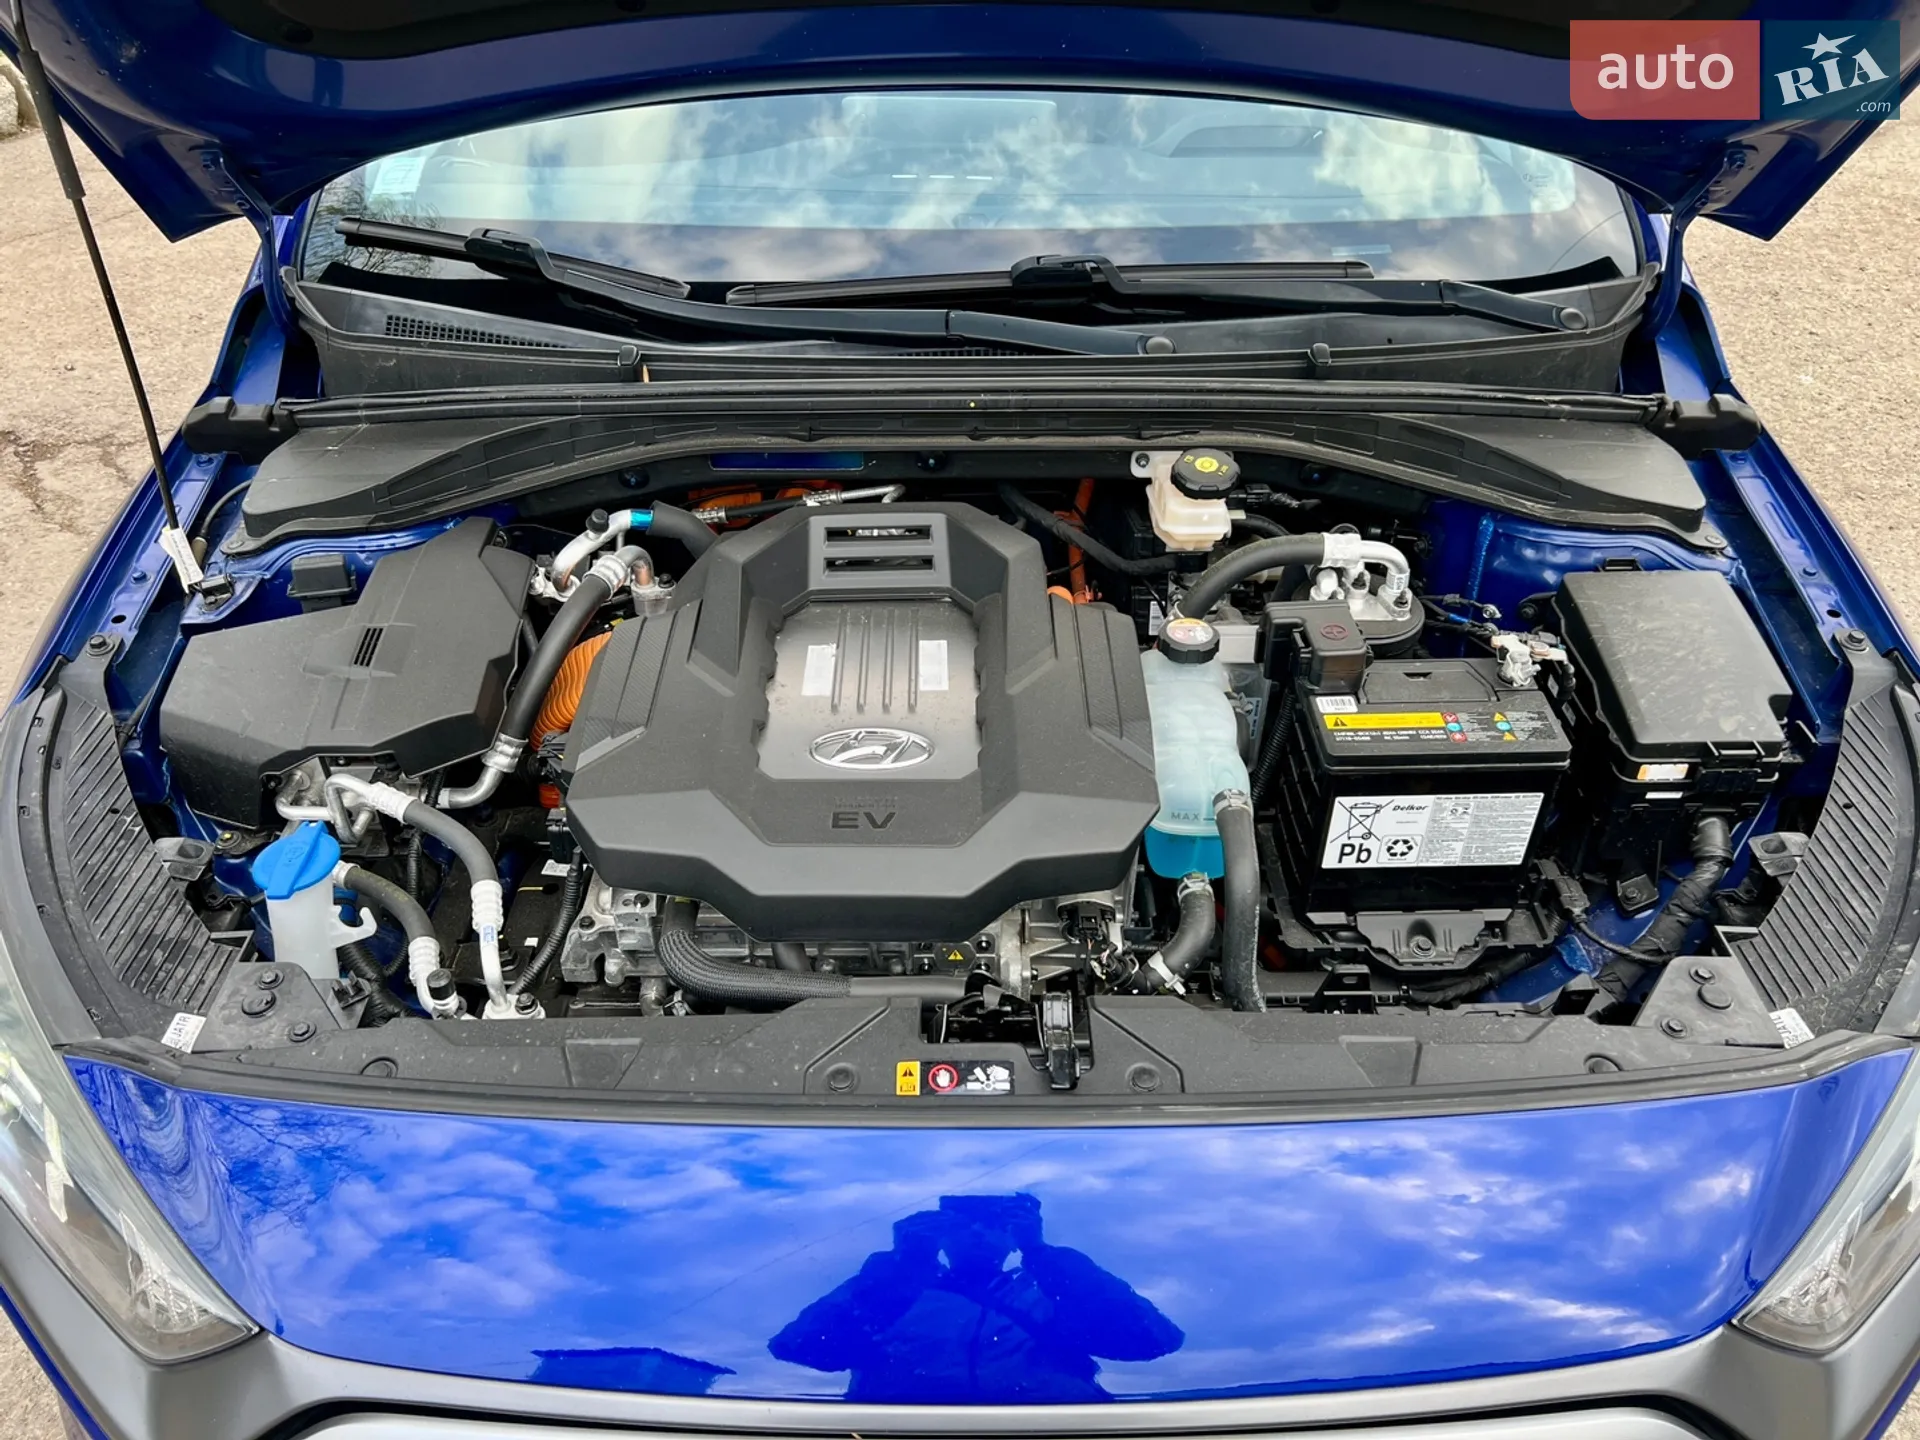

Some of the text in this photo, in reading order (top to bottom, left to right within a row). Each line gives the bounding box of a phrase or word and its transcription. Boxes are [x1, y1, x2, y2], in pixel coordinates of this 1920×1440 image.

[831, 811, 897, 830] EV
[1171, 812, 1200, 821] MAX
[1337, 843, 1372, 864] Pb
